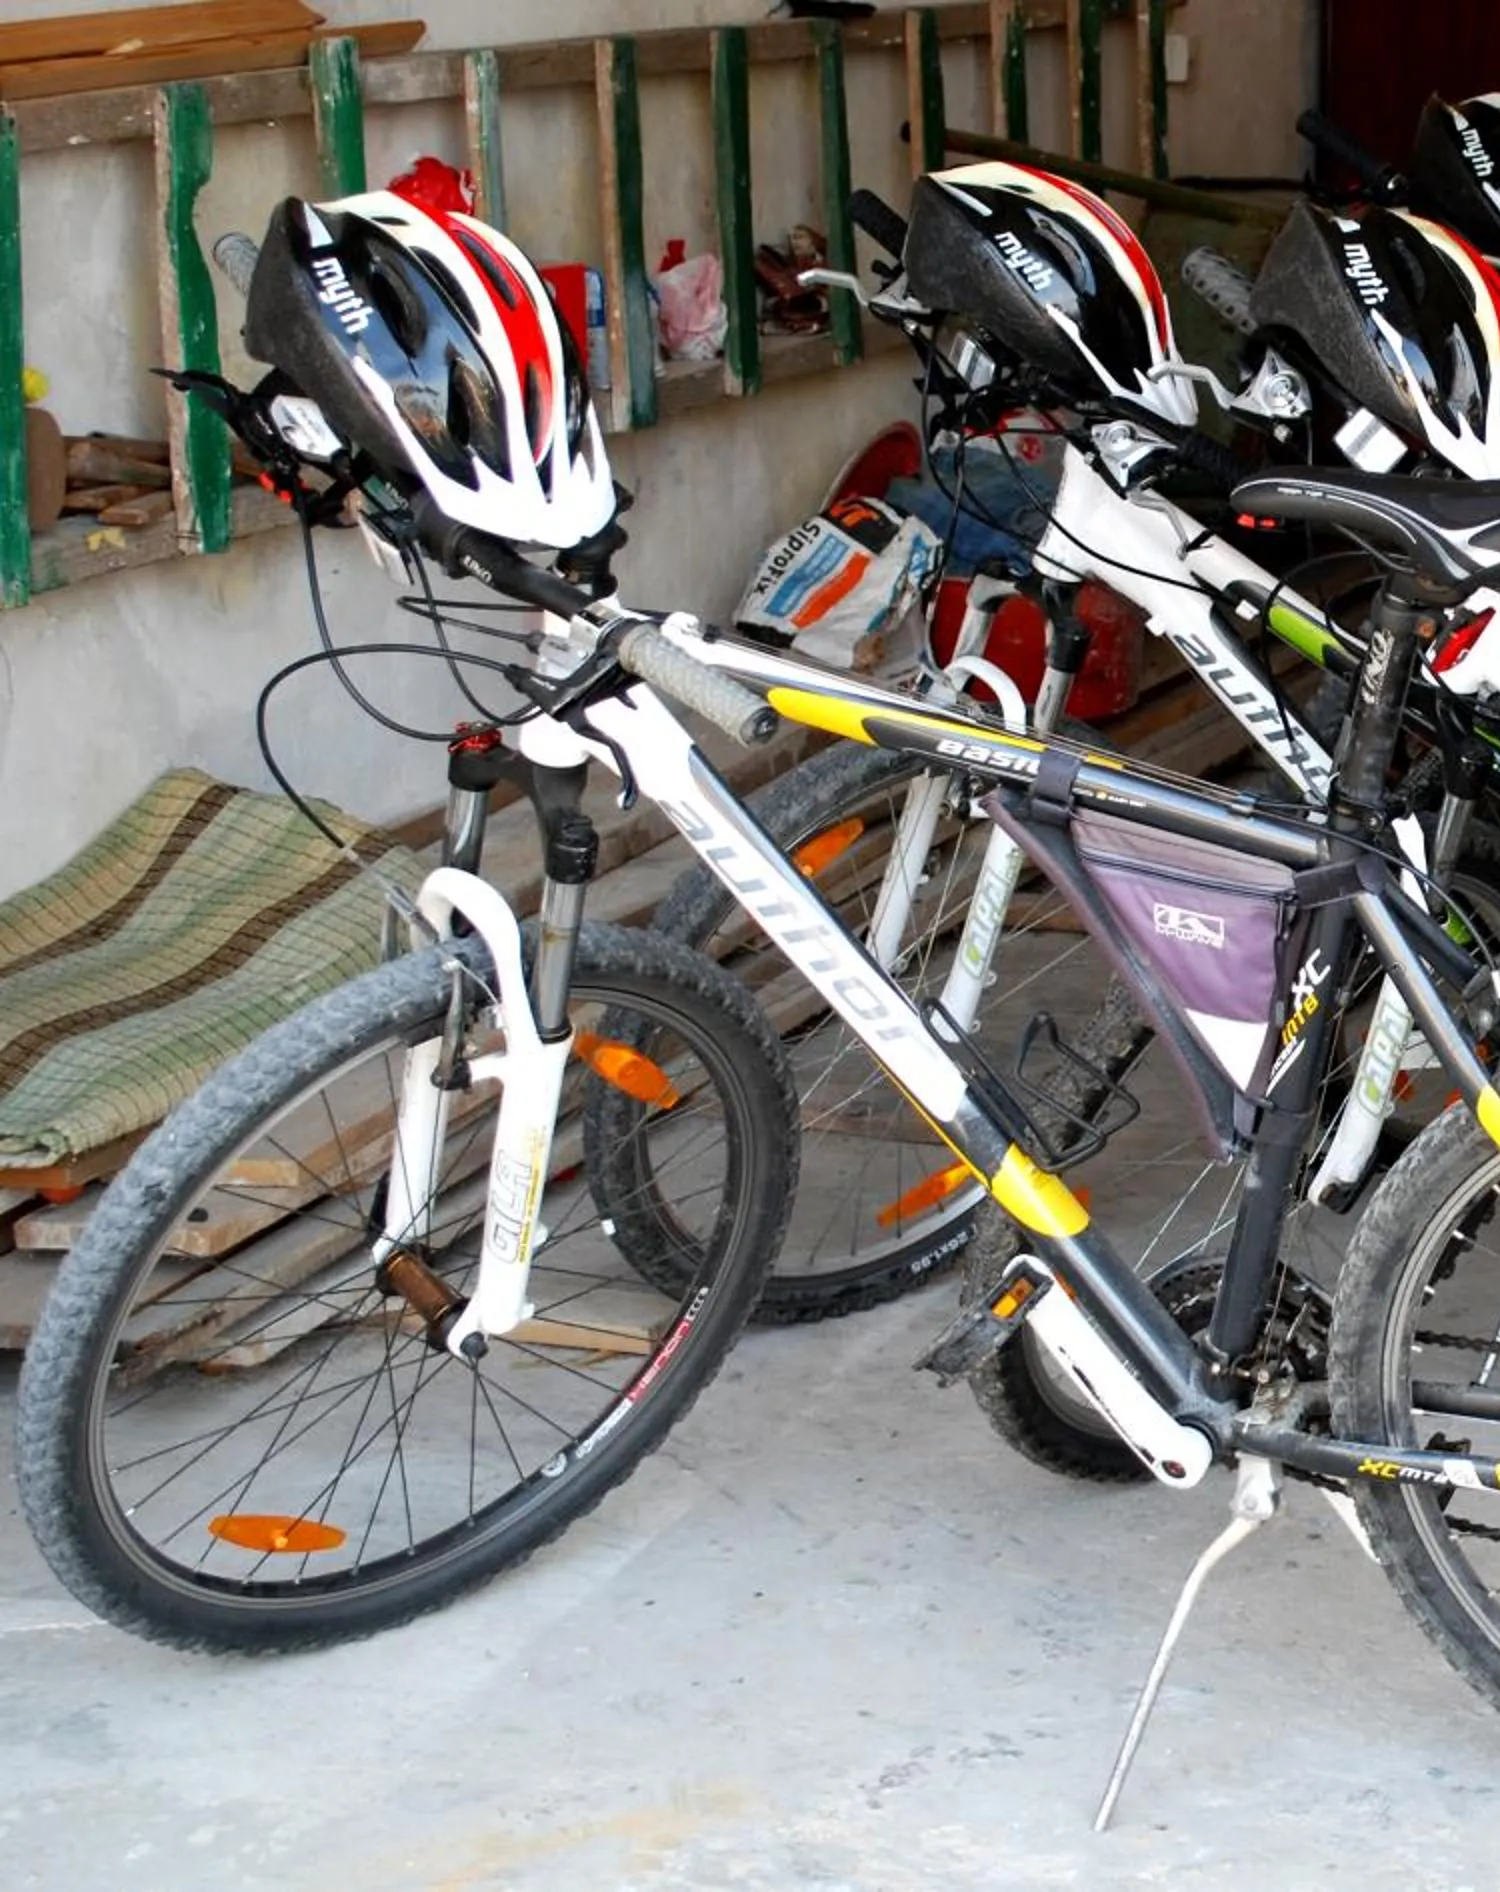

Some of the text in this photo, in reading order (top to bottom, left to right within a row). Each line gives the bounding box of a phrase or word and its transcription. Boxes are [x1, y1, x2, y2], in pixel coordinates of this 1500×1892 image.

[1461, 127, 1495, 178] myth
[995, 230, 1054, 294] myth
[1343, 242, 1391, 307] myth
[311, 256, 375, 335] myth
[668, 798, 926, 1048] author
[1291, 947, 1332, 1011] XC
